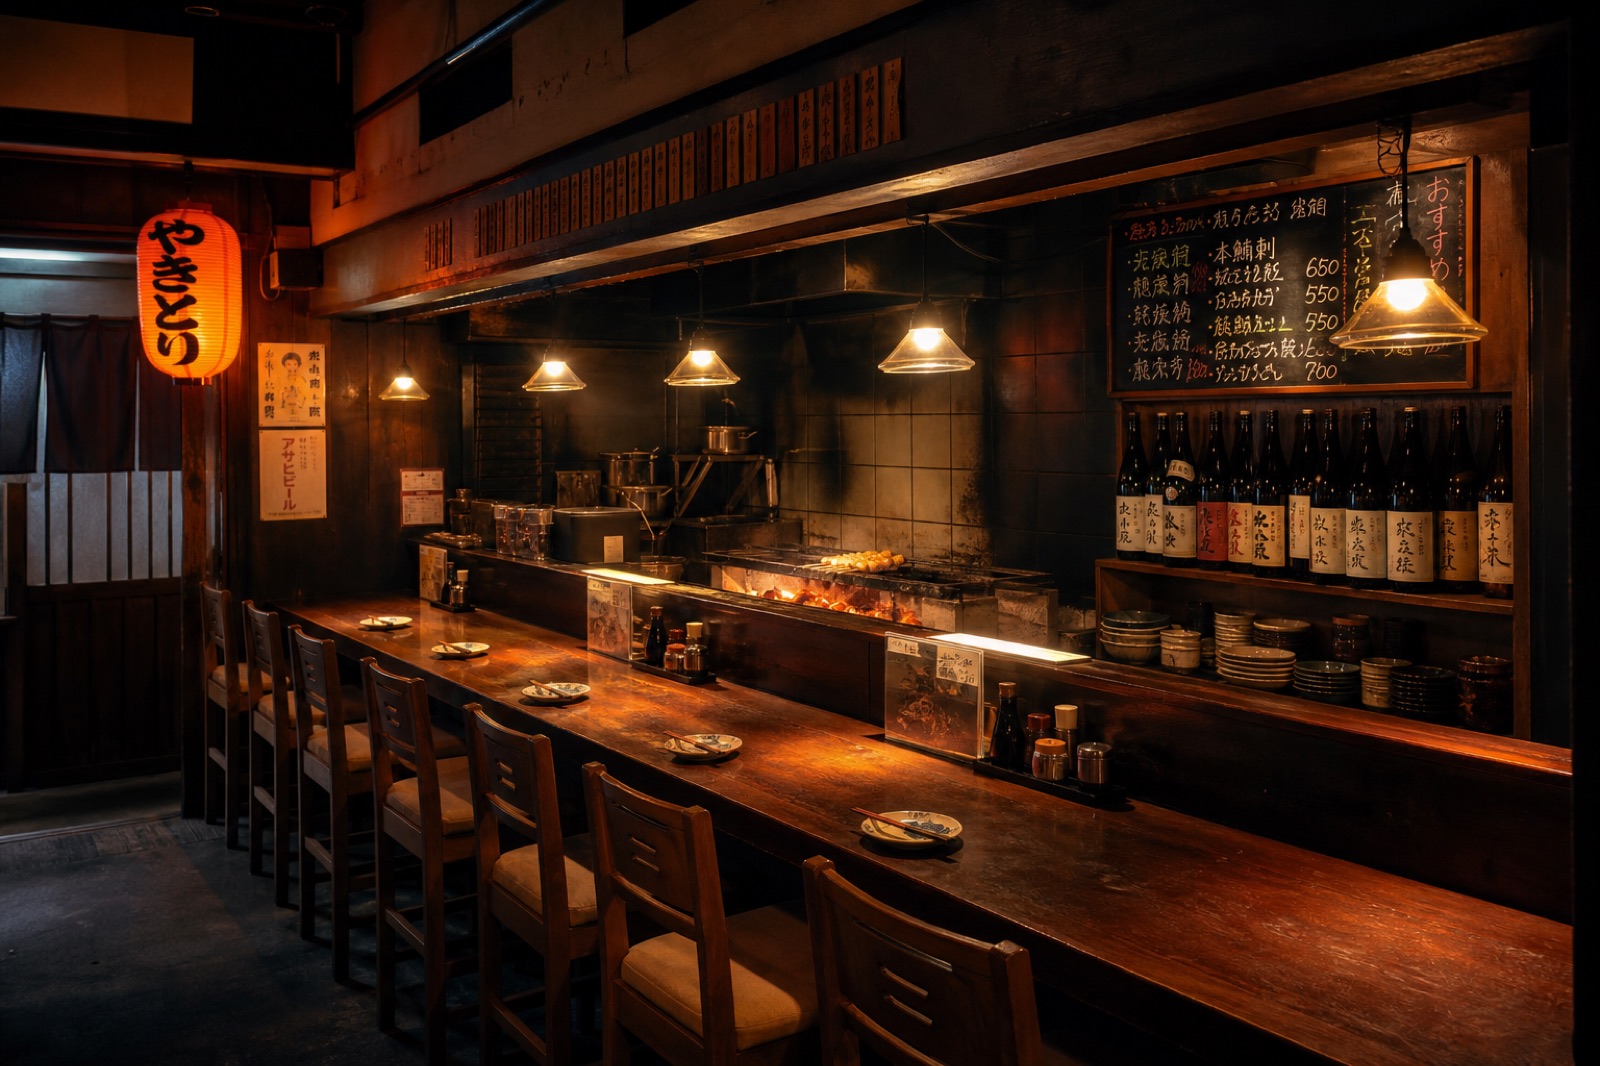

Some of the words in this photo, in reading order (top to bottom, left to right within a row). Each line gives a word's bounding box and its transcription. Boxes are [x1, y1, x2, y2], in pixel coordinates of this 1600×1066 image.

[1426, 175, 1450, 281] おすすめ
[1305, 257, 1340, 278] 650
[148, 218, 205, 366] やきとり
[1304, 283, 1340, 304] 550
[1305, 312, 1339, 333] 550
[1305, 361, 1338, 382] 700
[282, 437, 296, 511] アサヒビール
